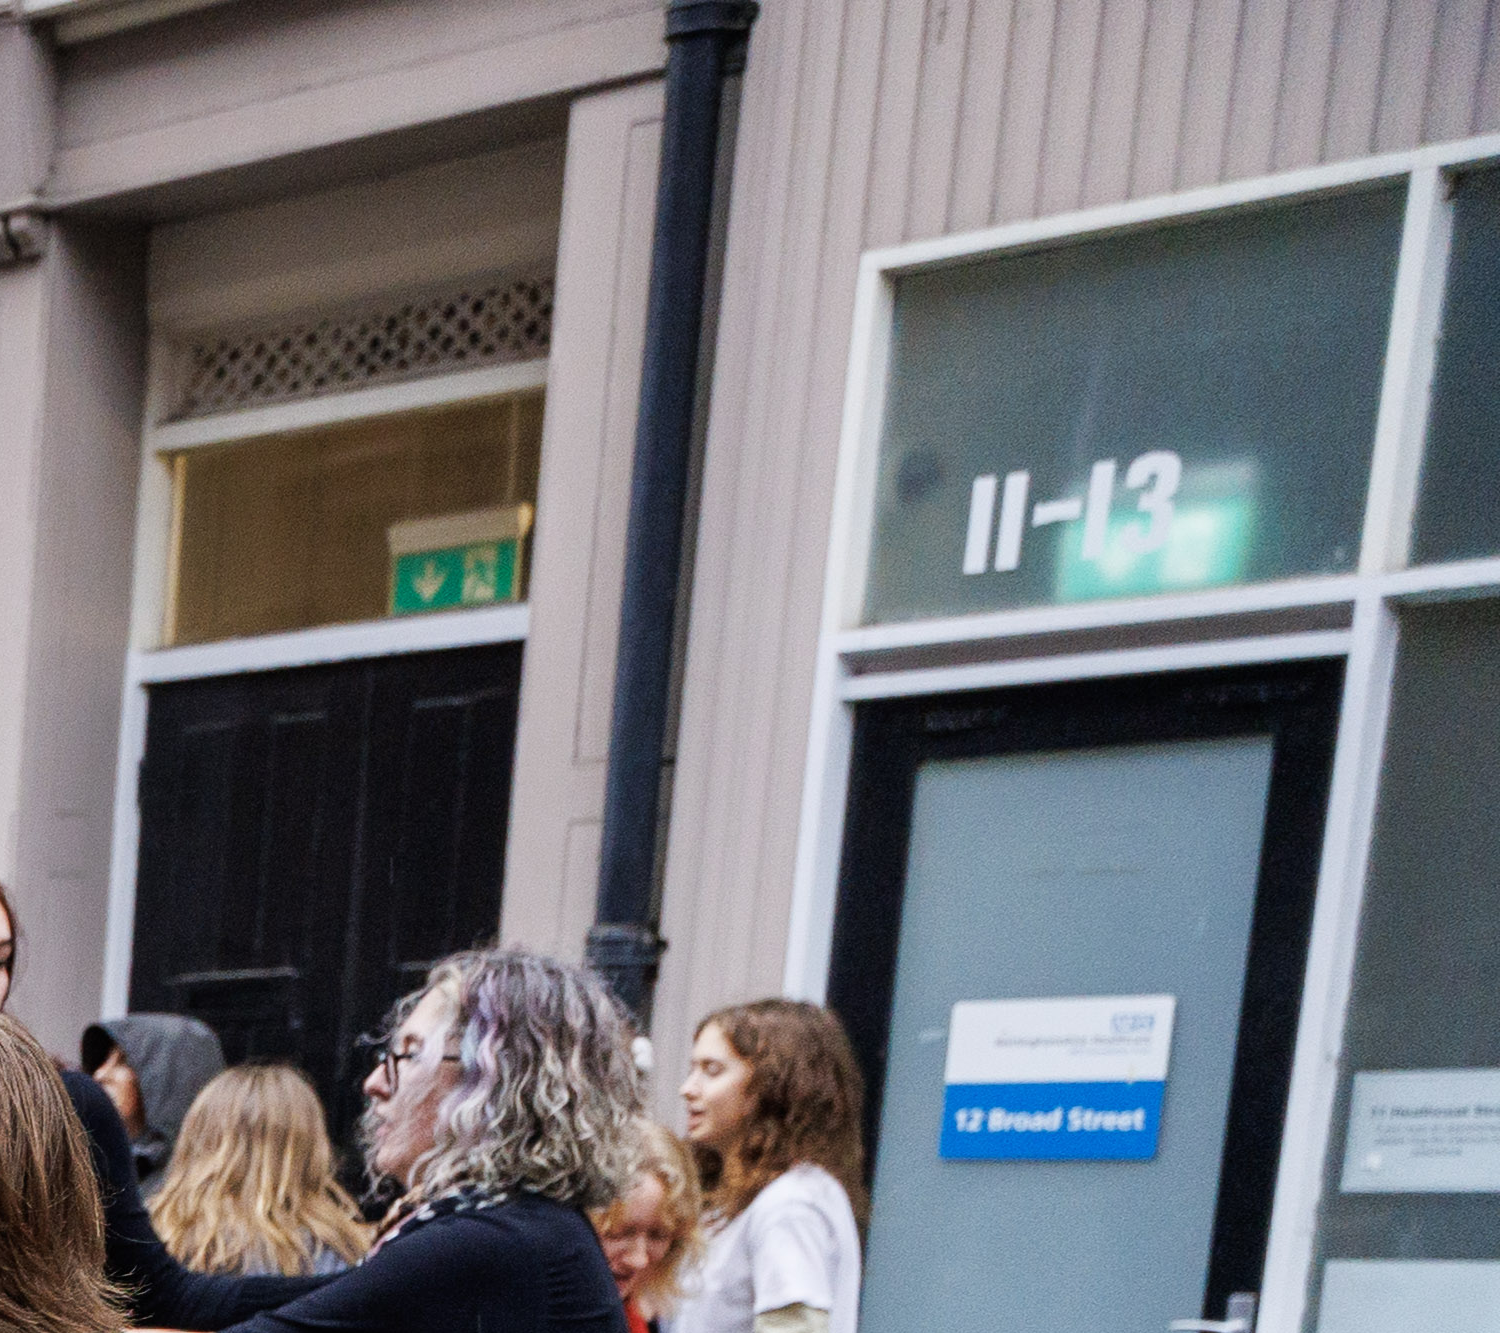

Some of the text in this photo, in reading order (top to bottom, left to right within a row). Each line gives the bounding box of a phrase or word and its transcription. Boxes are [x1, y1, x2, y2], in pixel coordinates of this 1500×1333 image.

[962, 451, 1184, 576] 11-13
[956, 1105, 1146, 1133] 12 Broad Street
